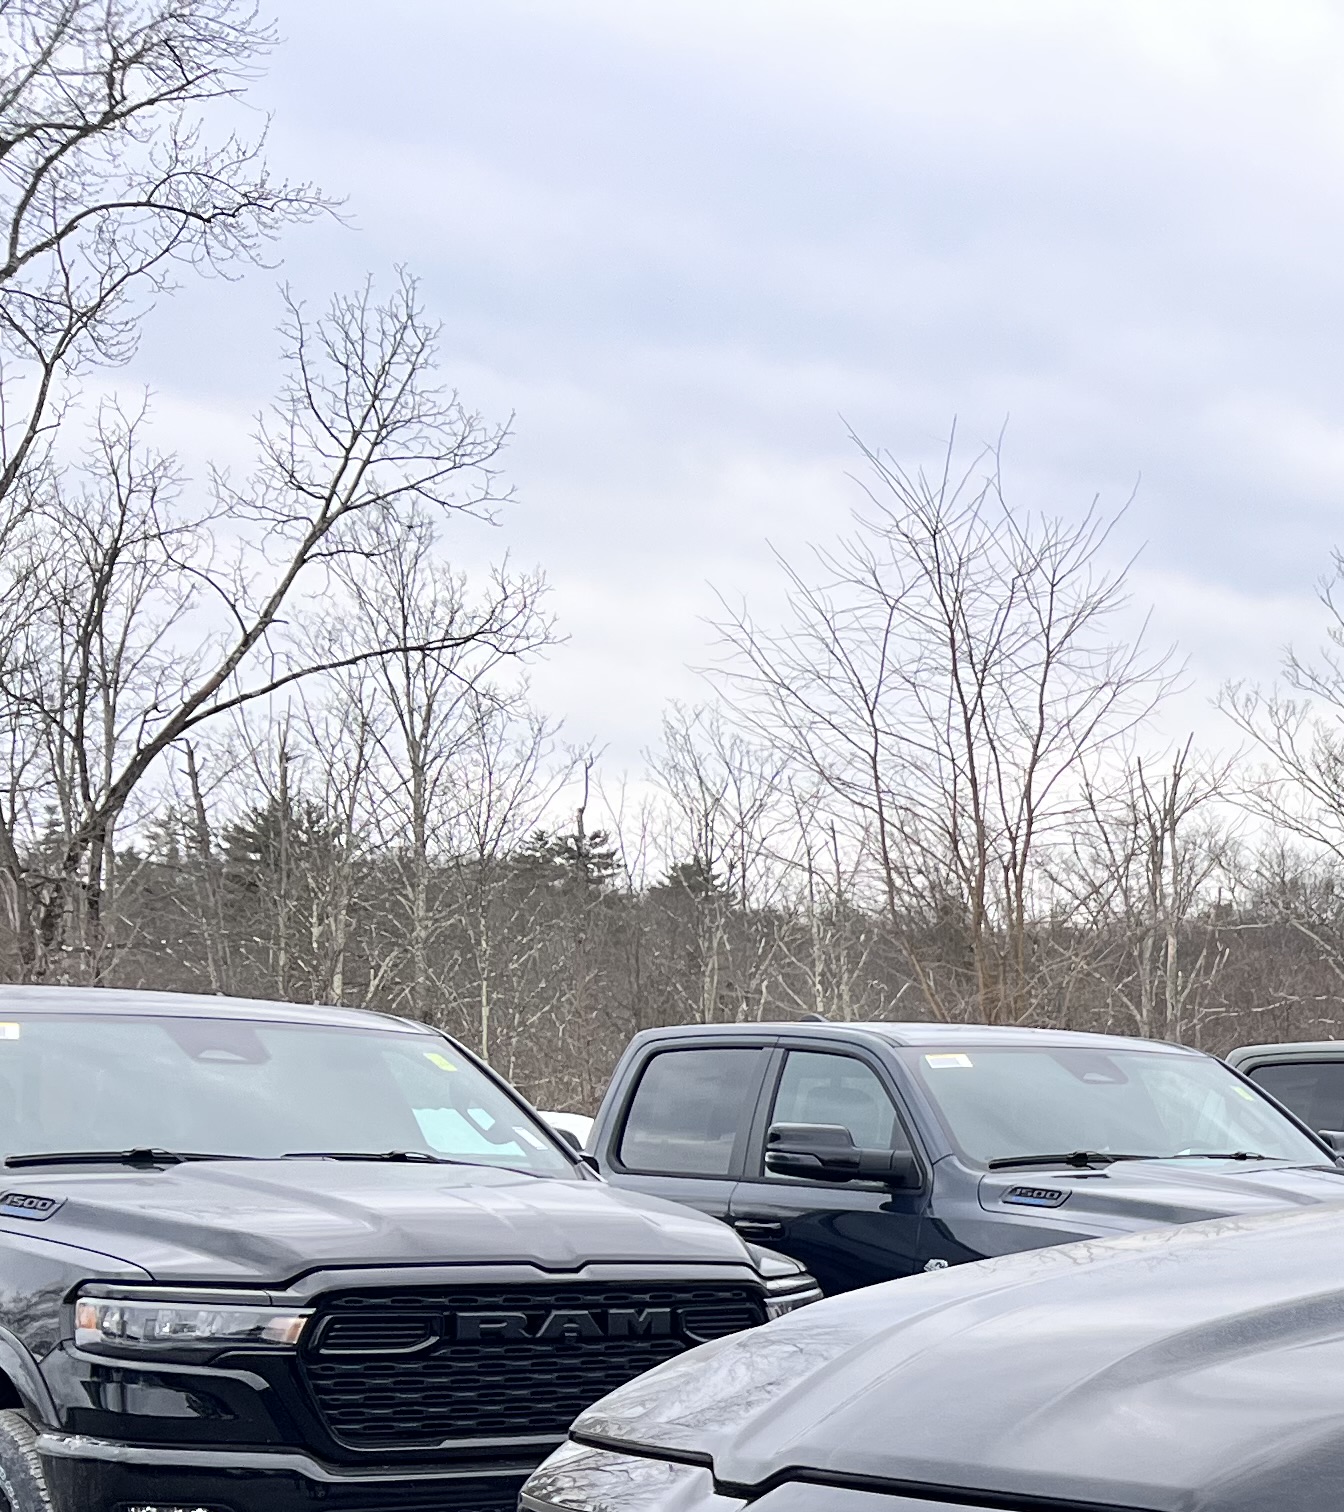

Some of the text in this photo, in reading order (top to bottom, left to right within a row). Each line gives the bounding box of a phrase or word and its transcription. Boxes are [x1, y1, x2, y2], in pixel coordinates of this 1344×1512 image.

[1015, 1188, 1060, 1199] 1500
[5, 1194, 53, 1211] 1500
[456, 1307, 672, 1339] RAM
